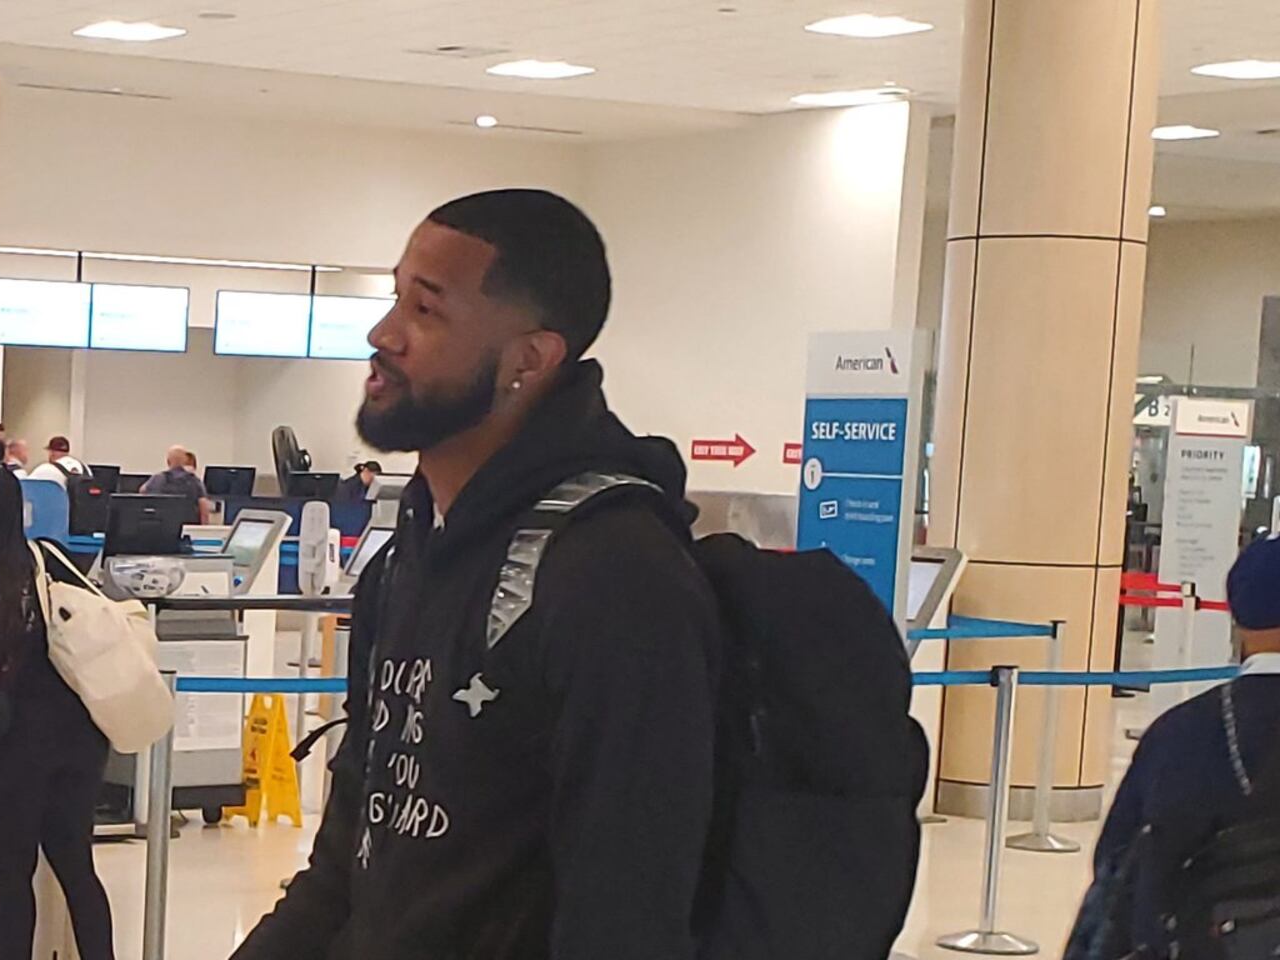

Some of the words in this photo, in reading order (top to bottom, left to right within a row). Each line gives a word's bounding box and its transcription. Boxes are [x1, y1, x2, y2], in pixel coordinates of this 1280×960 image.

[835, 355, 884, 371] American
[811, 421, 897, 441] SELF-SERVICE
[1181, 449, 1225, 460] PRIORITY
